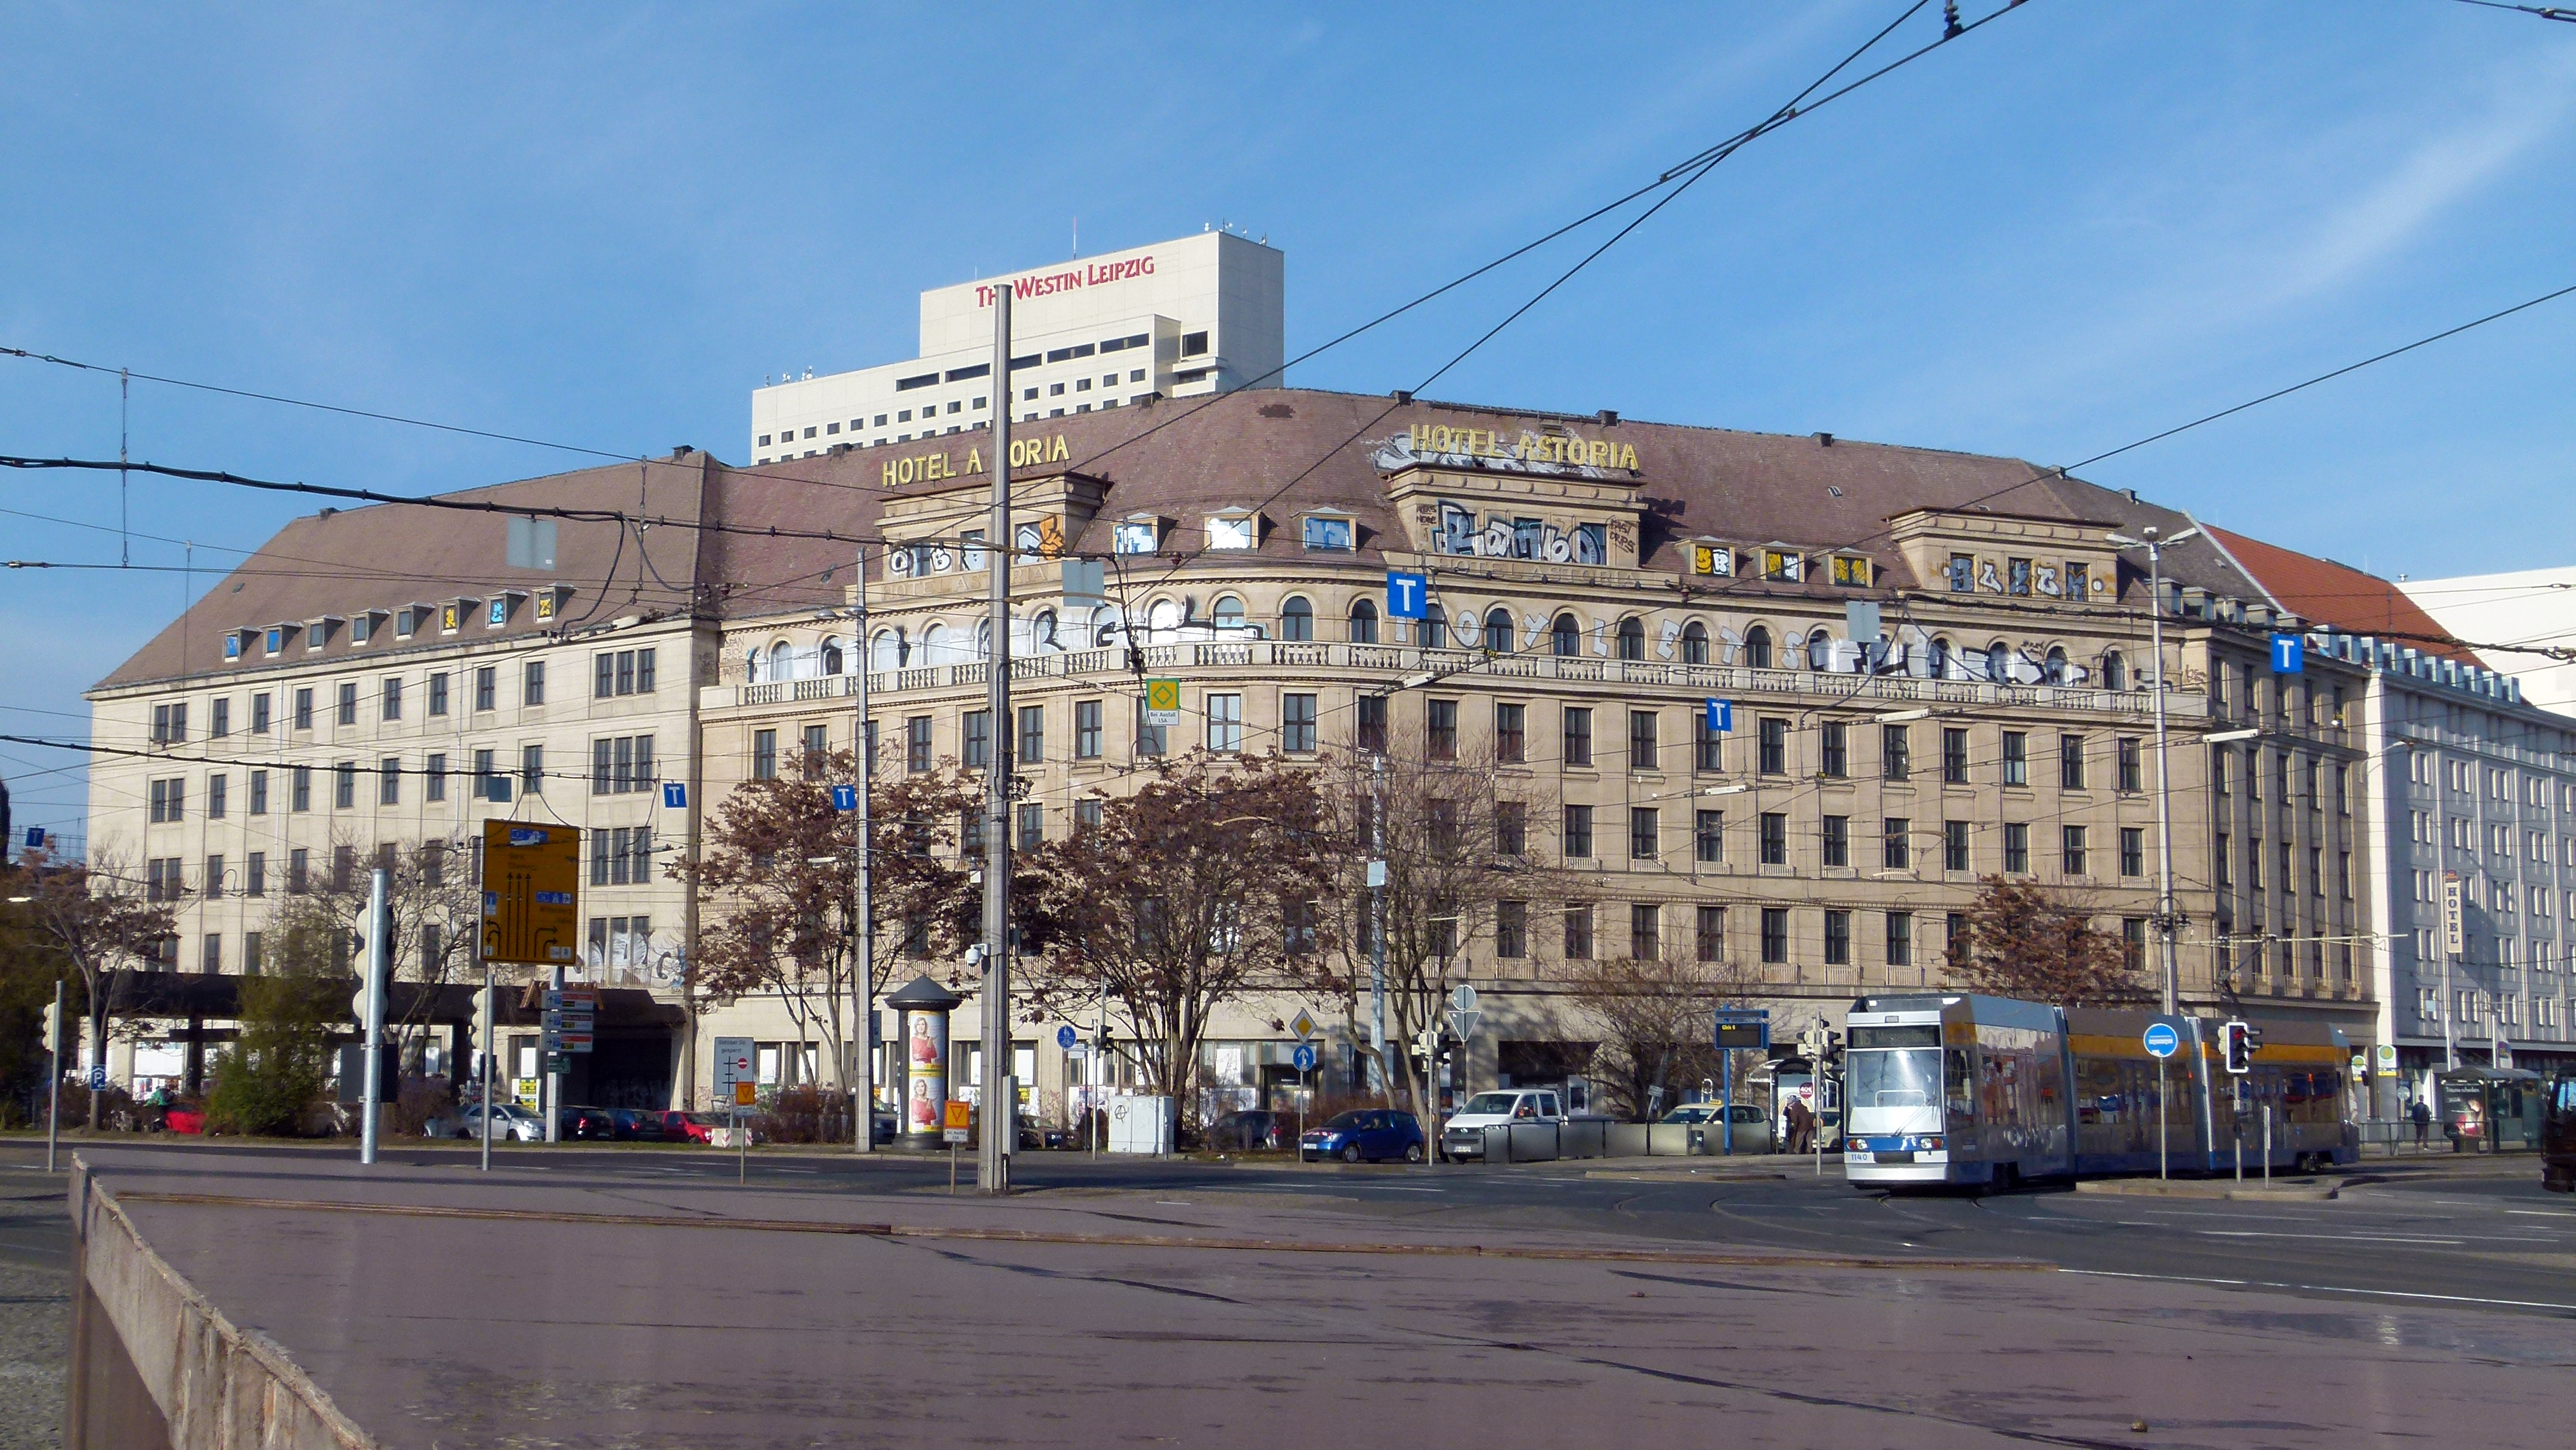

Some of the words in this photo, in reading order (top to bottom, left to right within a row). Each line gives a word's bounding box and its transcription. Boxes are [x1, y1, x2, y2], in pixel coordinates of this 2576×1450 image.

[976, 286, 995, 308] TH
[1013, 270, 1082, 300] WESTIN
[1087, 256, 1155, 286] LEIPZIG
[882, 451, 956, 488] HOTEL
[965, 433, 1070, 475] AORIA
[1410, 423, 1506, 458] HOTEL
[1515, 434, 1639, 470] ASTORIA
[955, 565, 1048, 591] ASTRIA
[1396, 579, 1416, 612] T
[2278, 639, 2294, 668] T
[1711, 702, 1726, 726] T
[668, 786, 680, 805] T
[837, 788, 849, 806] T
[2447, 887, 2459, 944] HOTEL
[94, 1072, 102, 1083] P
